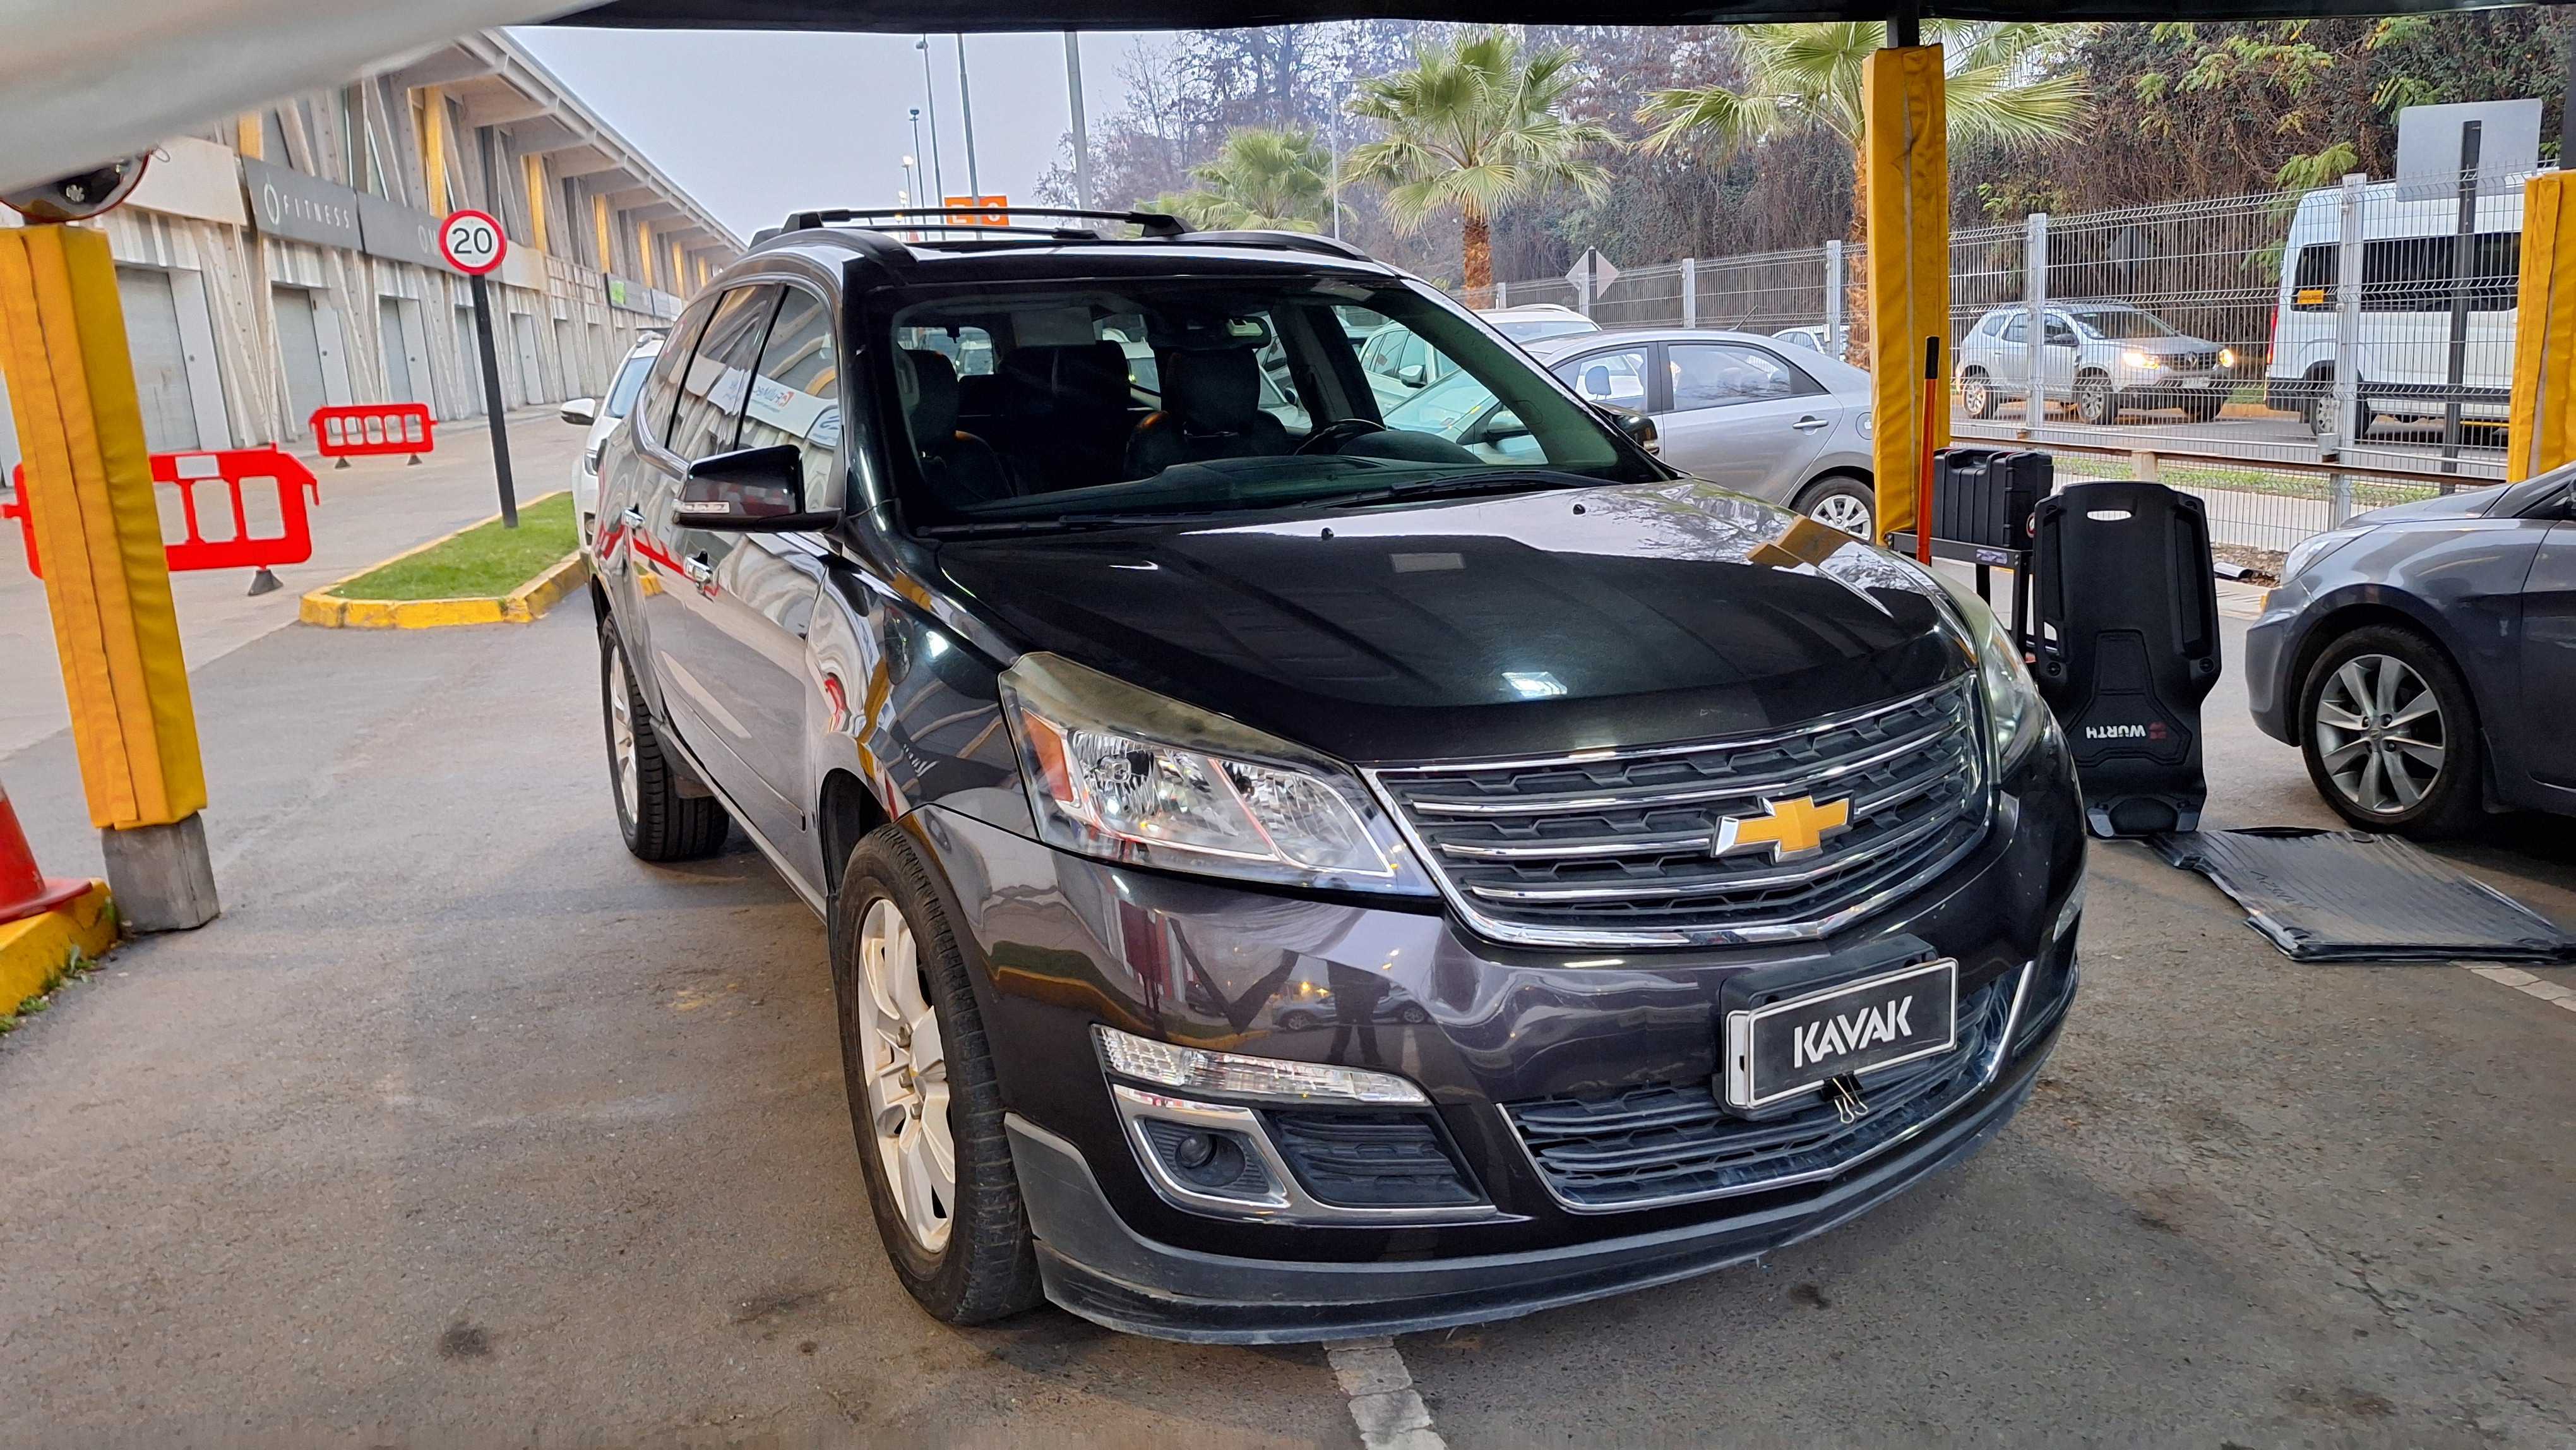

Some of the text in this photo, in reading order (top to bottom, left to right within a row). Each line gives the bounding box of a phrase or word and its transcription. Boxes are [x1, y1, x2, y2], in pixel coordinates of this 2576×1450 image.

[452, 227, 492, 254] 20
[2085, 724, 2147, 739] WÜRTH
[1794, 995, 1912, 1069] KAVAK
